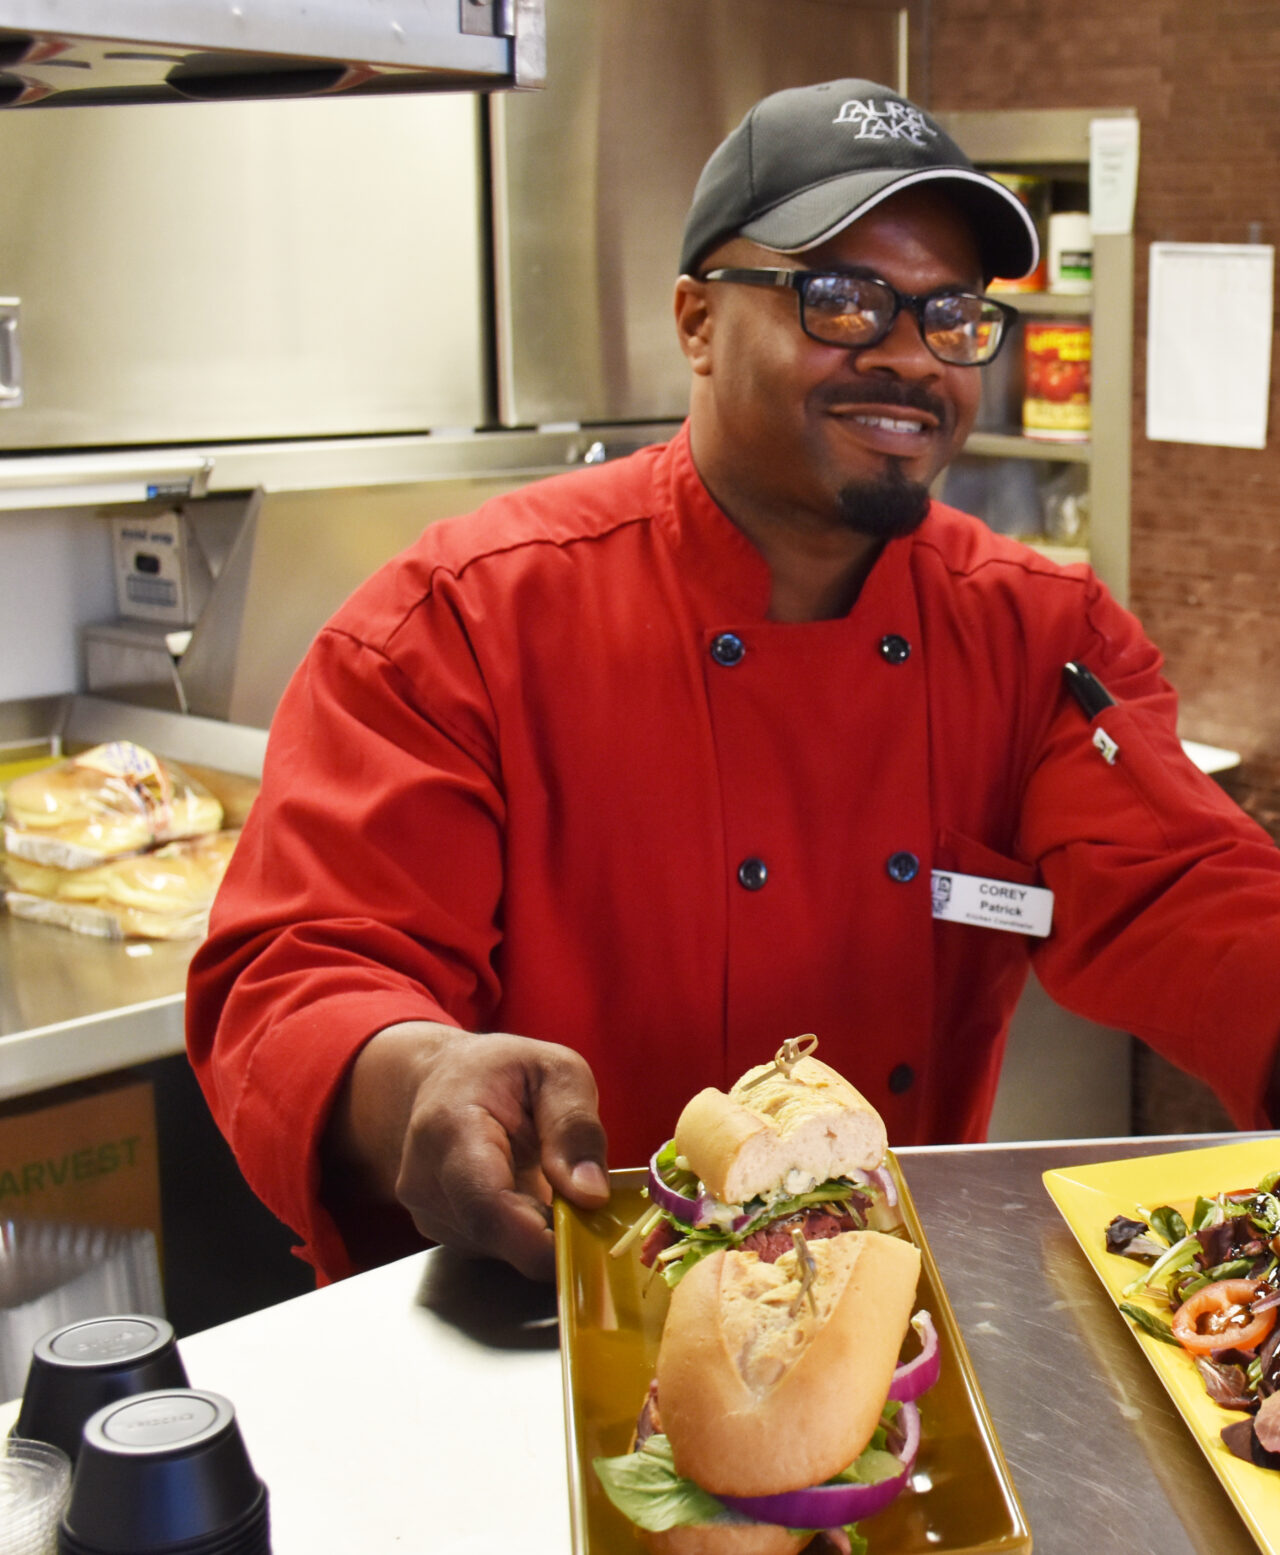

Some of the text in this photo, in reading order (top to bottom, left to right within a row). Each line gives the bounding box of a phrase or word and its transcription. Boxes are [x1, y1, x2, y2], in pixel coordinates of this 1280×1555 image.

[832, 99, 938, 137] LAUREL
[854, 117, 927, 147] LAKE
[979, 883, 1027, 901] COREY
[980, 900, 1022, 918] Patrick
